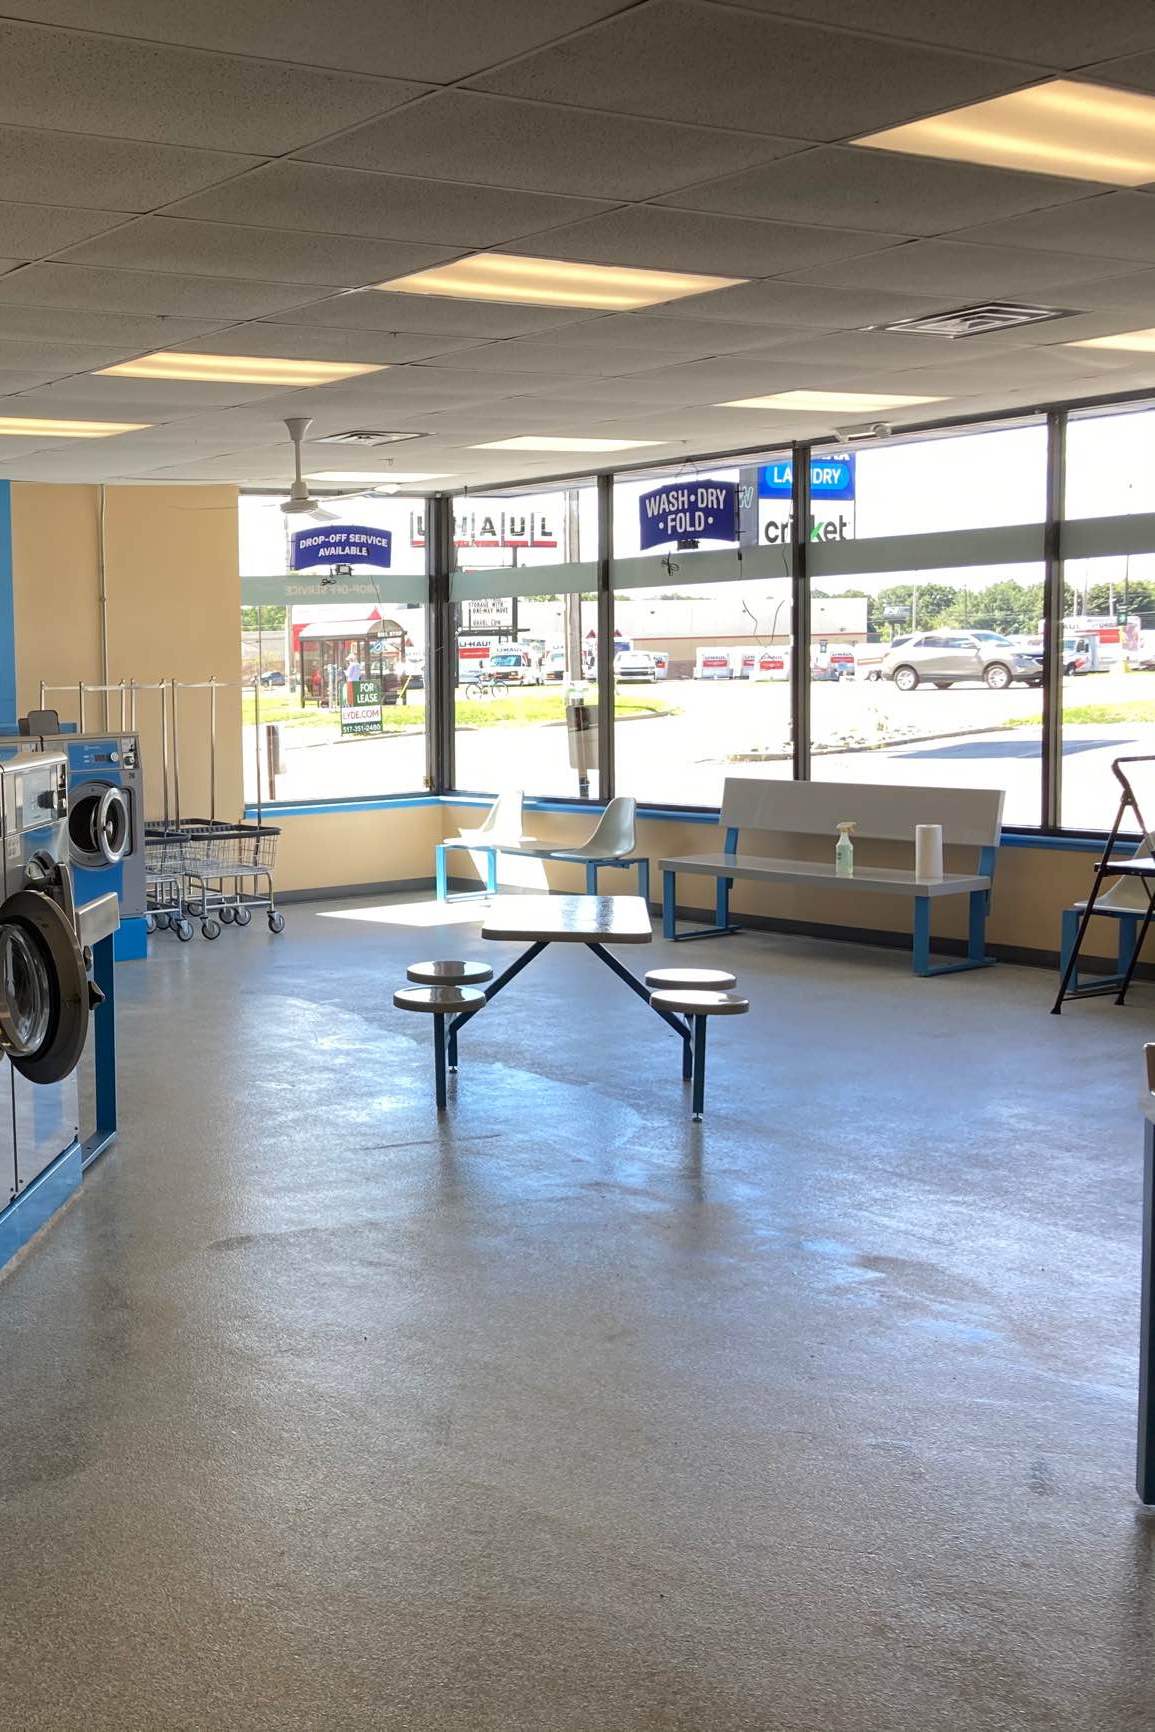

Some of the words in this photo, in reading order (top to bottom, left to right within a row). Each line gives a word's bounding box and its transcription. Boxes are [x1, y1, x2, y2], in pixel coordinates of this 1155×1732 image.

[773, 466, 842, 485] LADRY
[666, 512, 705, 535] FOLD
[764, 514, 847, 543] criket
[299, 533, 348, 549] DROP-OFF
[349, 533, 389, 547] SERVICE
[318, 546, 369, 557] AVAILABLE
[359, 682, 375, 693] FOR
[356, 693, 379, 704] LEASE
